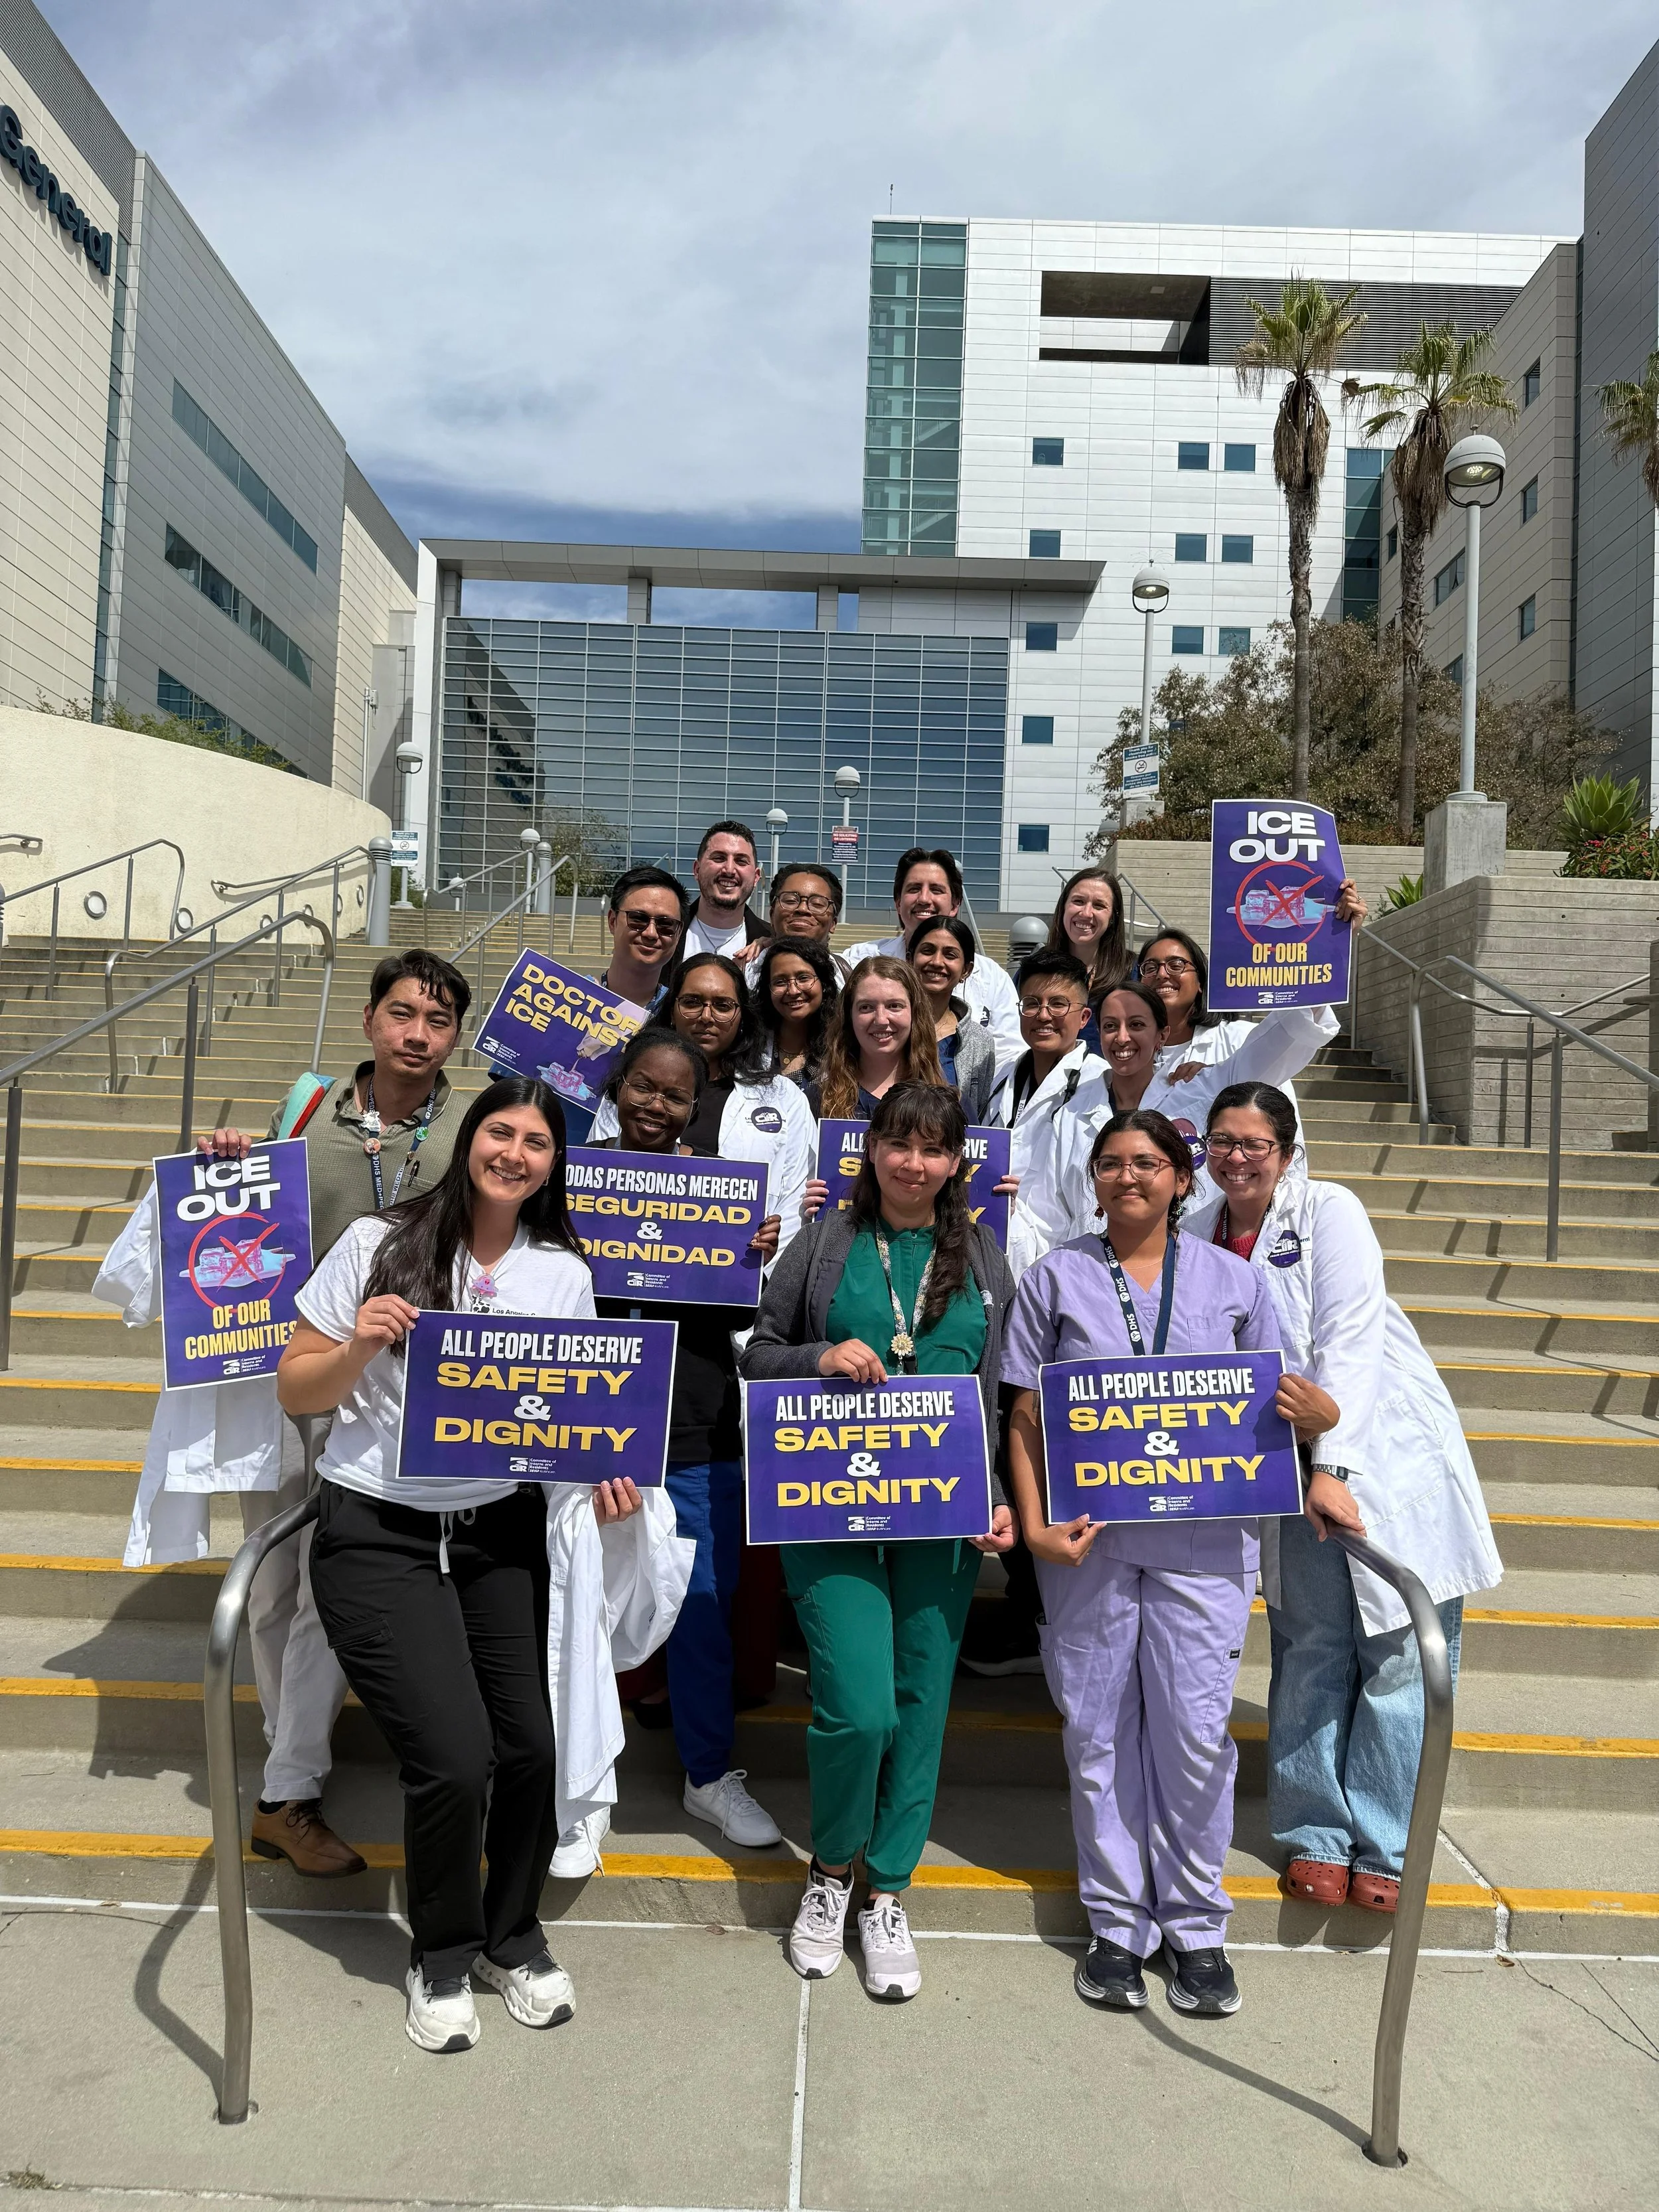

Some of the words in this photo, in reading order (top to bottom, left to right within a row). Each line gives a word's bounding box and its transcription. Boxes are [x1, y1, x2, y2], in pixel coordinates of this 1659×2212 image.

[0, 104, 112, 276] General
[1248, 811, 1317, 835] ICE
[1229, 838, 1325, 863] OUT
[1252, 943, 1271, 964] OF
[1275, 942, 1307, 962] OUR
[1226, 963, 1333, 988] COMMUNITIES
[504, 998, 551, 1033] ICE
[522, 964, 641, 1037] DOCTOR
[194, 1155, 270, 1191] ICE
[565, 1164, 605, 1189] ODAS
[606, 1168, 686, 1196] PERSONAS
[689, 1175, 758, 1201] MERECEN
[177, 1182, 281, 1221] OUT
[565, 1193, 751, 1224] SEGURIDAD
[636, 1221, 663, 1240] &
[579, 1238, 735, 1266] DIGNIDAD
[1104, 1246, 1115, 1261] DHS
[1116, 1277, 1127, 1291] DHS
[212, 1305, 234, 1329] OF
[236, 1299, 271, 1324] OUR
[1127, 1313, 1137, 1331] DHS
[441, 1329, 476, 1357] ALL
[480, 1331, 555, 1361] PEOPLE
[557, 1334, 643, 1364] DESERVE
[437, 1362, 633, 1395] SAFETY
[1068, 1374, 1099, 1402] ALL
[1102, 1371, 1169, 1400] PEOPLE
[1172, 1368, 1256, 1396] DESERVE
[514, 1395, 551, 1421] &
[775, 1396, 807, 1422] ALL
[810, 1393, 876, 1420] PEOPLE
[879, 1391, 955, 1418] DESERVE
[1068, 1400, 1250, 1432] SAFETY
[434, 1417, 637, 1452] DIGNITY
[774, 1423, 950, 1452] SAFETY
[1144, 1431, 1180, 1457] &
[847, 1452, 881, 1477] &
[1075, 1455, 1265, 1488] DIGNITY
[778, 1477, 961, 1507] DIGNITY
